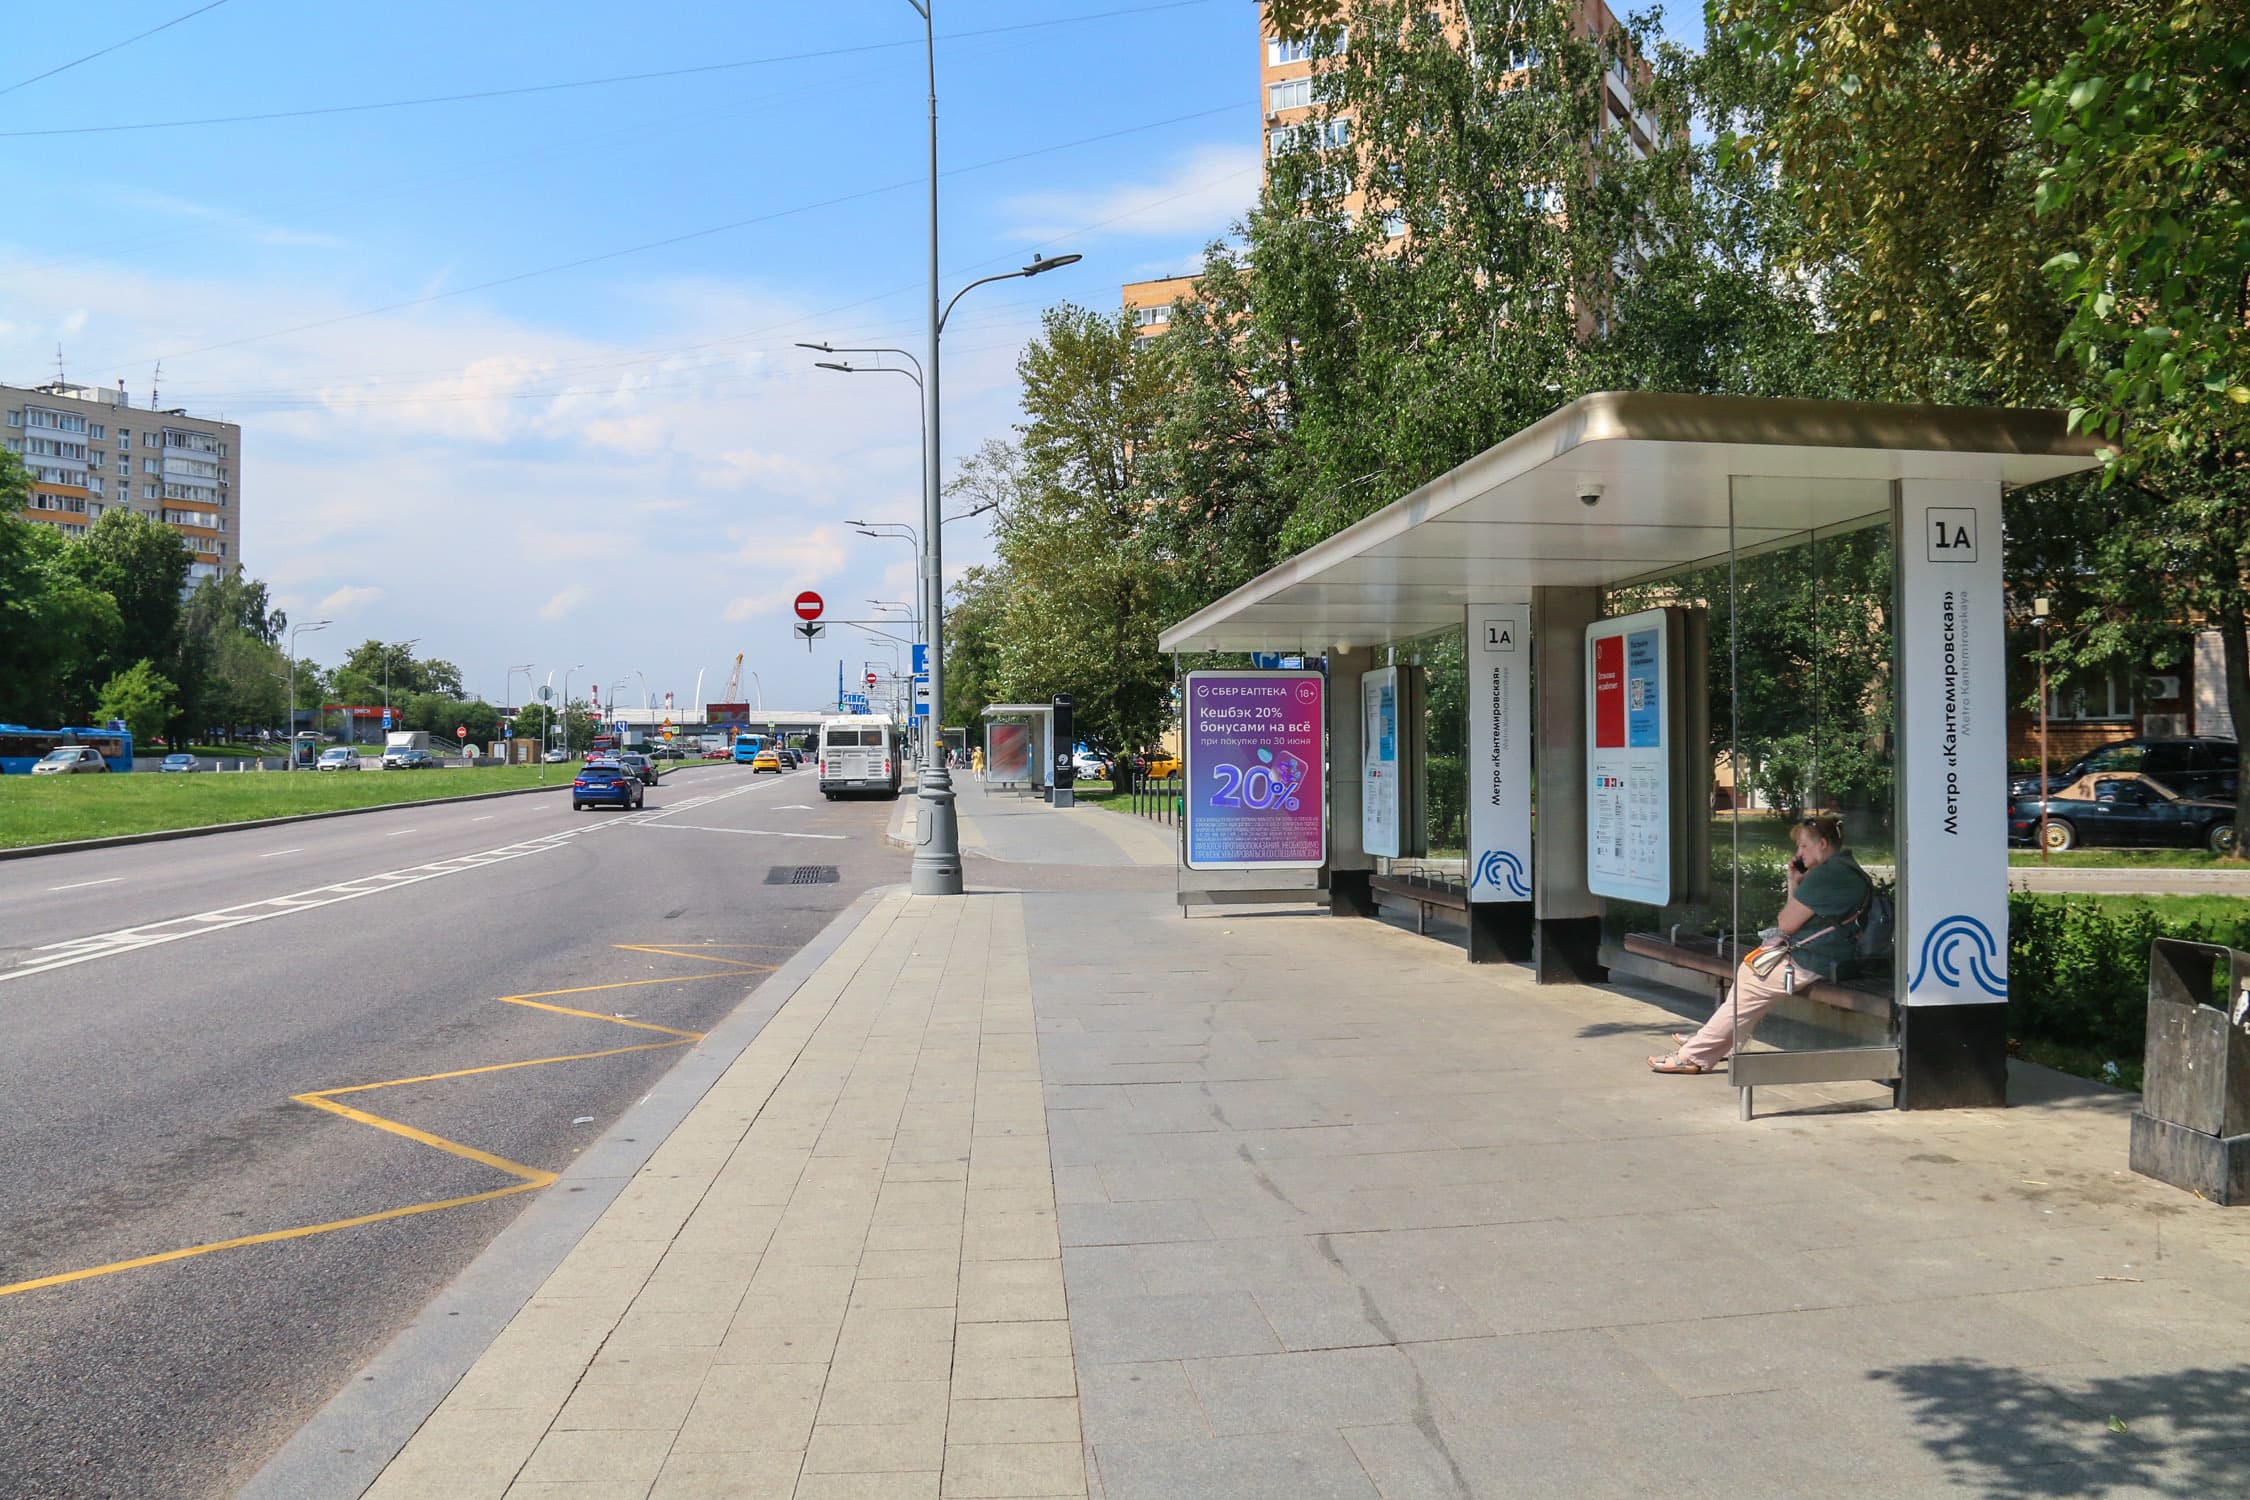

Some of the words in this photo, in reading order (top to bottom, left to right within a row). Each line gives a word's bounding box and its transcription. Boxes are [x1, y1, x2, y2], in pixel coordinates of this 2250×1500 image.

[1211, 687, 1239, 696] СБЕР
[1240, 687, 1288, 696] ЕАПТЕКА
[1942, 591, 1957, 767] «Кантемировская»
[1300, 689, 1314, 698] 18+
[1200, 706, 1252, 718] Кешбэк
[1255, 707, 1283, 718] 20%
[1491, 666, 1502, 768] «Кантемировская»
[1200, 721, 1265, 735] бонусами
[1269, 723, 1285, 732] на
[1288, 721, 1311, 732] всё
[1200, 739, 1218, 747] при
[1220, 739, 1258, 747] покупке
[1273, 737, 1286, 745] 30
[1210, 763, 1300, 811] 20%
[1491, 769, 1502, 806] Метро
[1943, 773, 1960, 836] Метро
